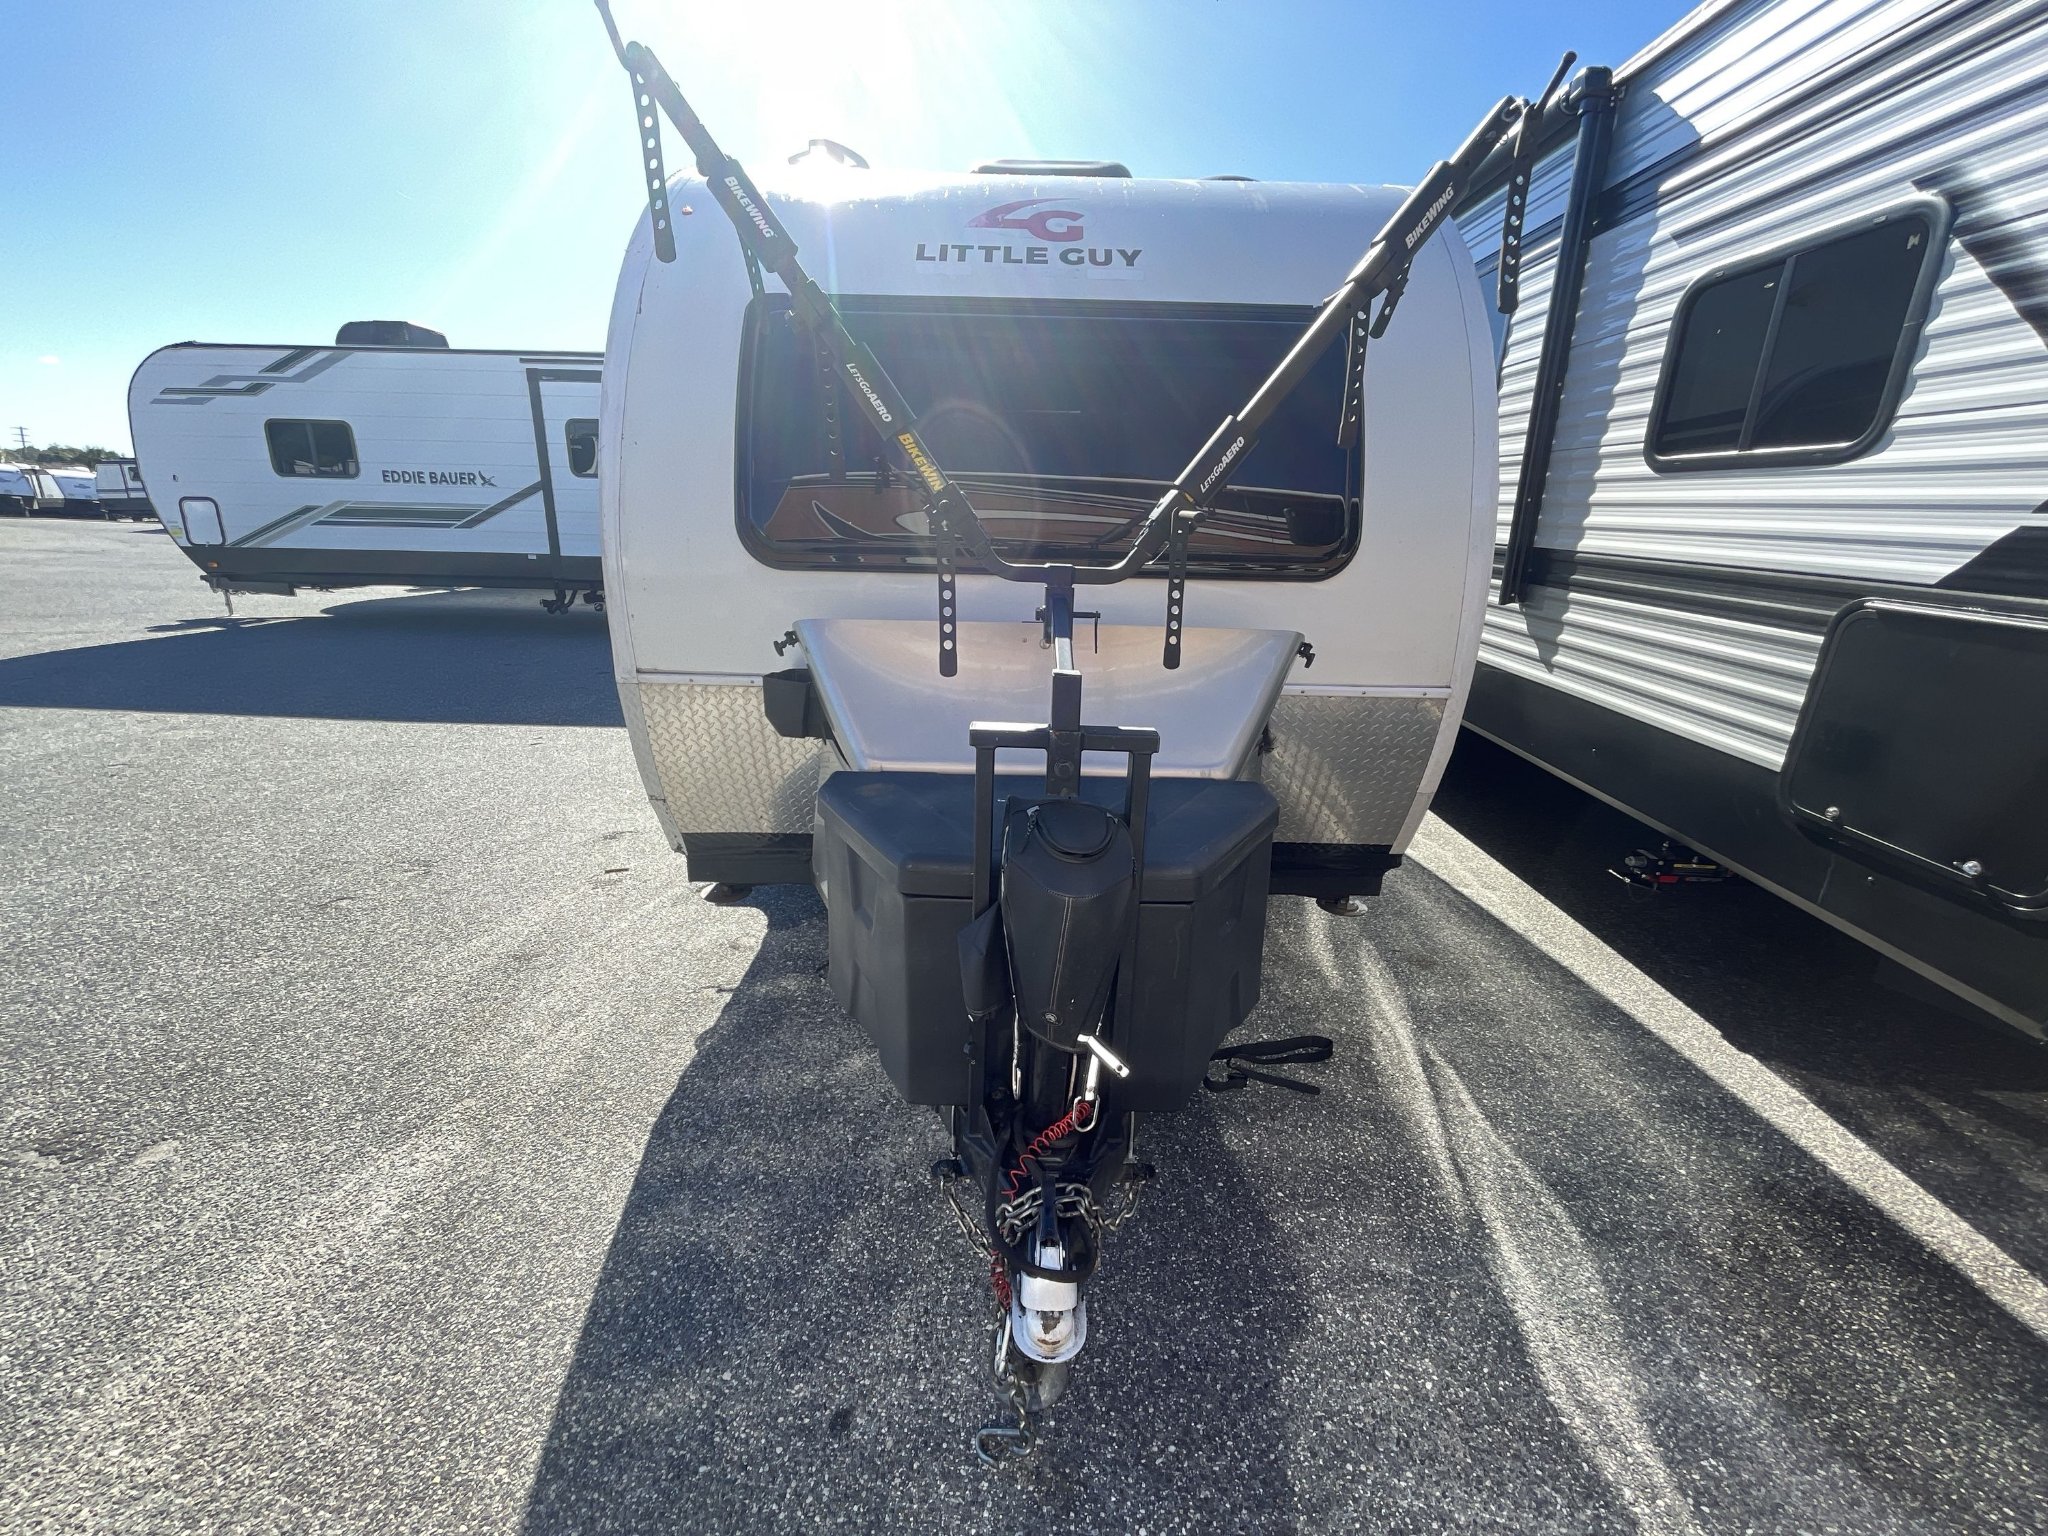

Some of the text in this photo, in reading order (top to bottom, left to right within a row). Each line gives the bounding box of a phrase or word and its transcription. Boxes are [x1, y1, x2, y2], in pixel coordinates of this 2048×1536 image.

[724, 176, 776, 239] BIKEWING
[1405, 183, 1455, 249] BIKEWING
[915, 243, 1142, 267] LITTLE GUY
[381, 470, 477, 485] EDDIE BAUER
[898, 433, 944, 491] BIKEWIN
